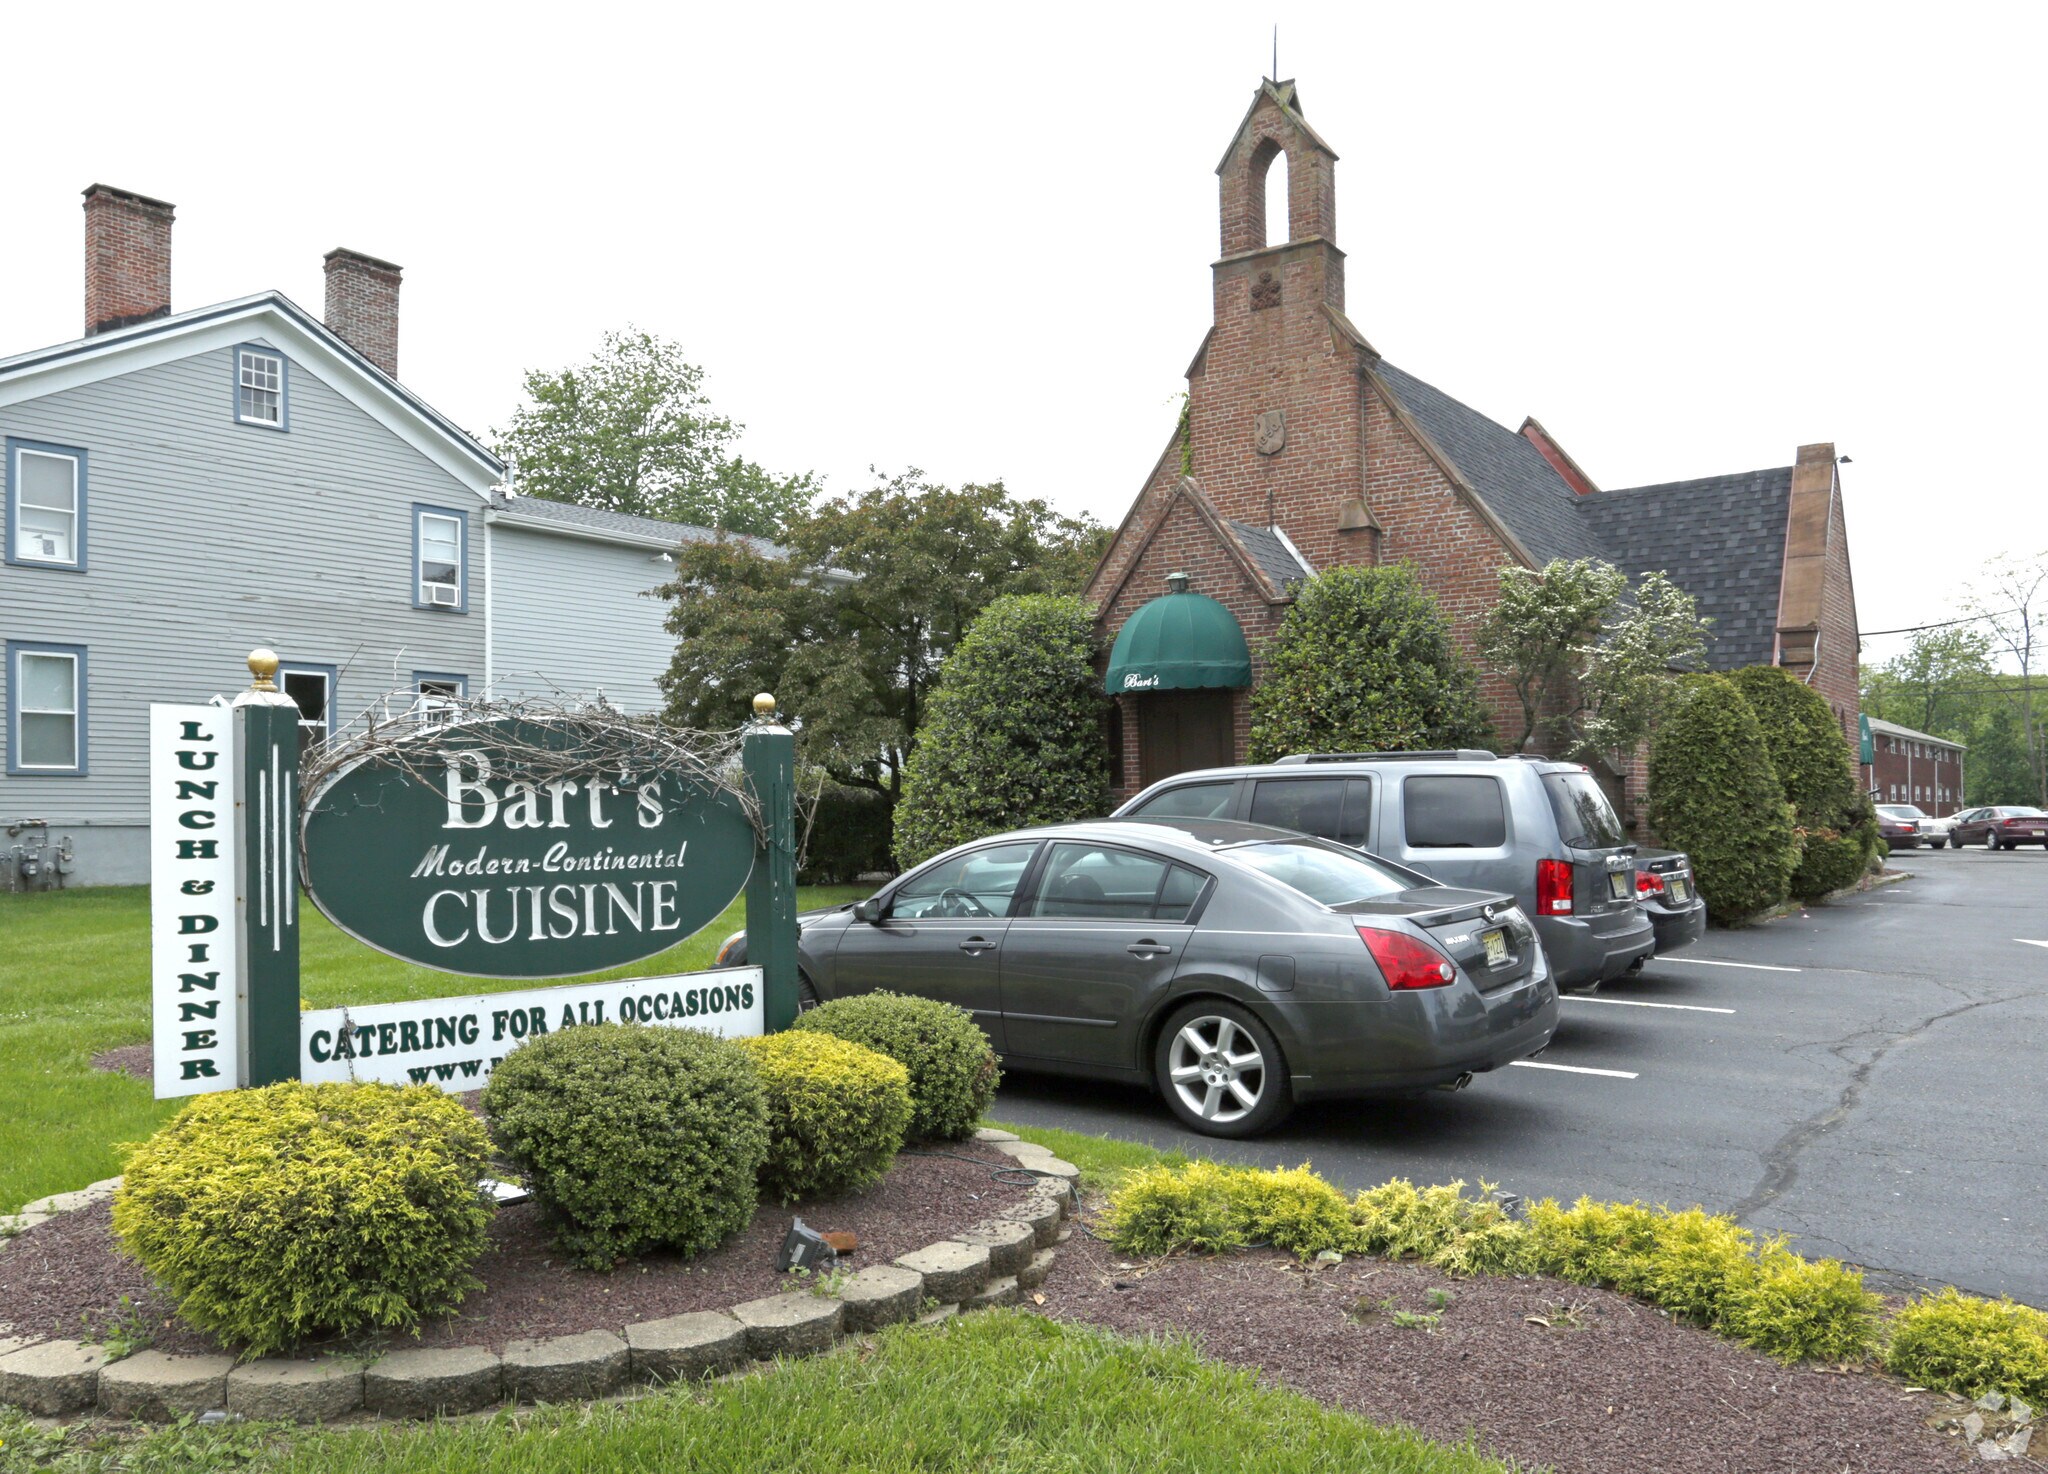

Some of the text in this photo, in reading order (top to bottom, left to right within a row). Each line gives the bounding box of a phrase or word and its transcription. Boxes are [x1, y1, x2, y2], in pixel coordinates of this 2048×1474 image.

[1124, 674, 1159, 688] Bart's
[438, 750, 664, 830] Bart's
[410, 841, 688, 878] Modern-Continental
[174, 721, 221, 1080] LUNCH & DINNER
[422, 880, 681, 948] CUISINE
[309, 983, 754, 1063] CATERING FOR ALL OCCASIONS
